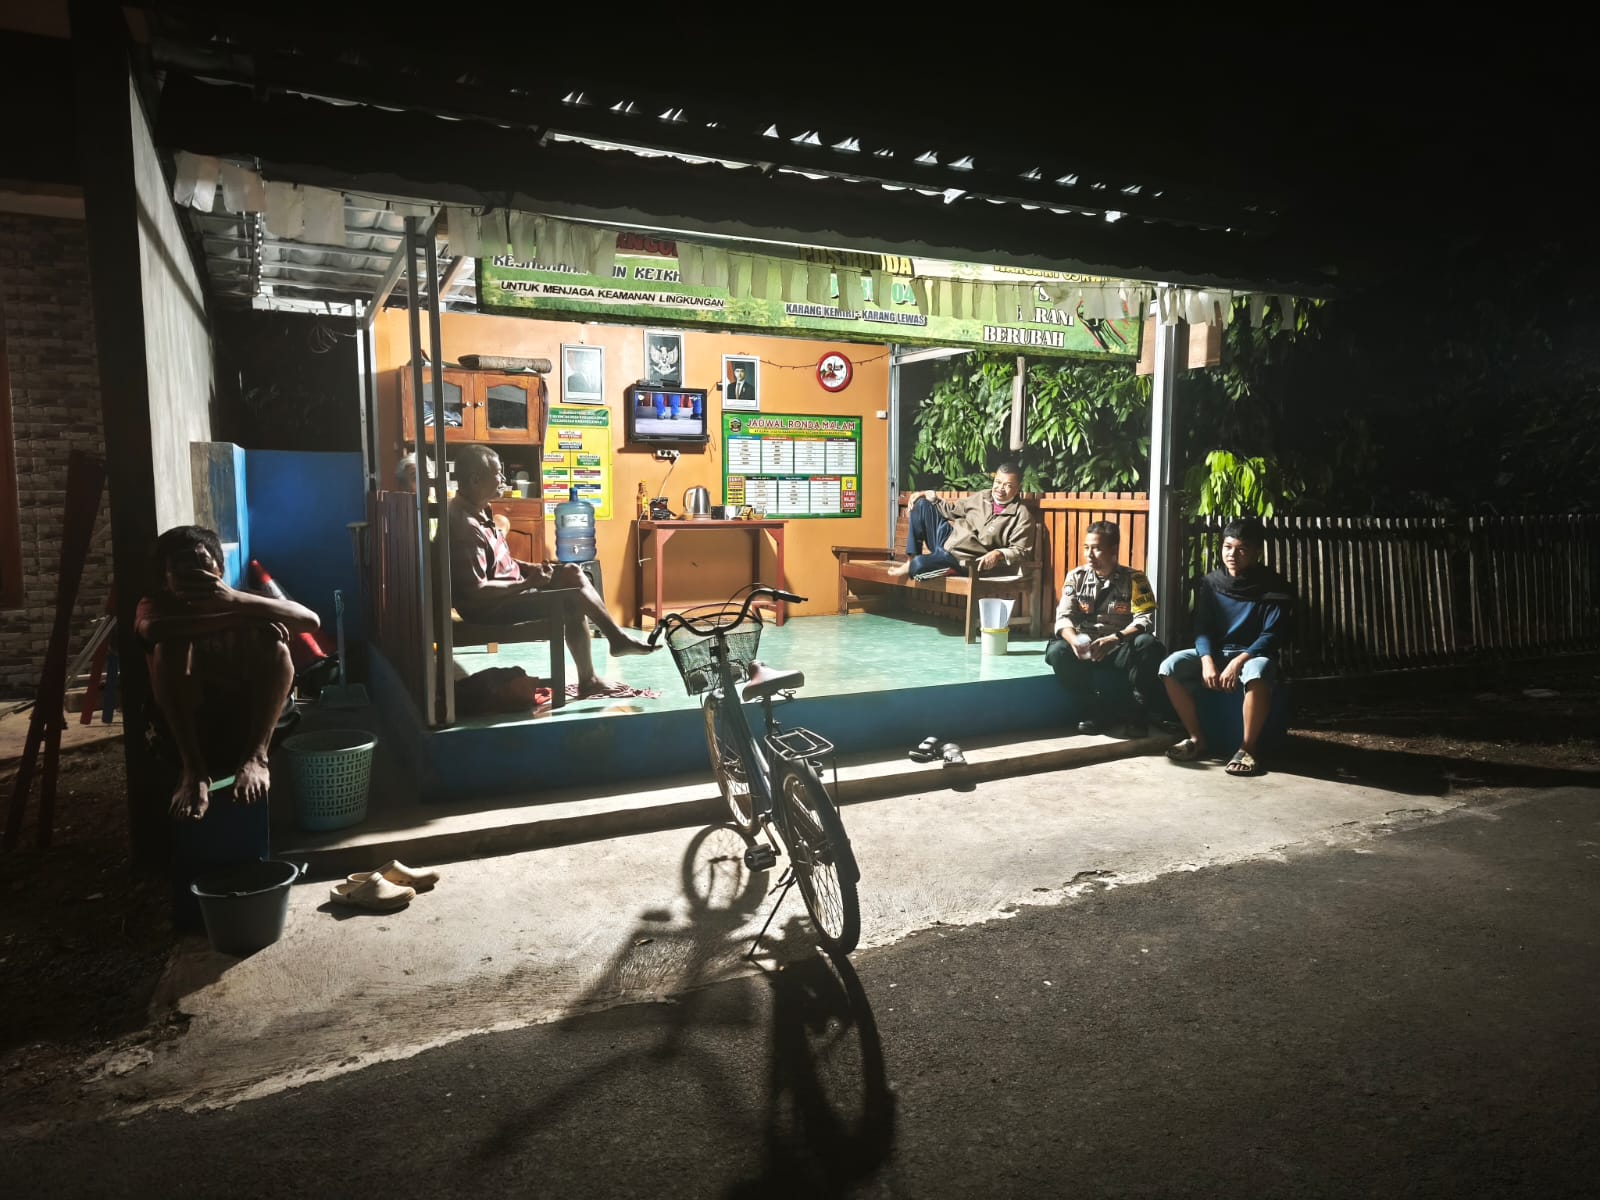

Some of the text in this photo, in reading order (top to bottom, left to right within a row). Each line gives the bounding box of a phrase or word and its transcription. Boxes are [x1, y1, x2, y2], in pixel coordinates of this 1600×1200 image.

[501, 281, 724, 307] UNTUK MENJAGA KEAMANAN LINGKUNGAN
[786, 304, 821, 315] KARANG
[862, 310, 895, 322] KARANG
[897, 313, 925, 325] LEWAS
[983, 325, 1065, 348] BERUBAH
[746, 418, 856, 431] JADWAL RONDA MALAM
